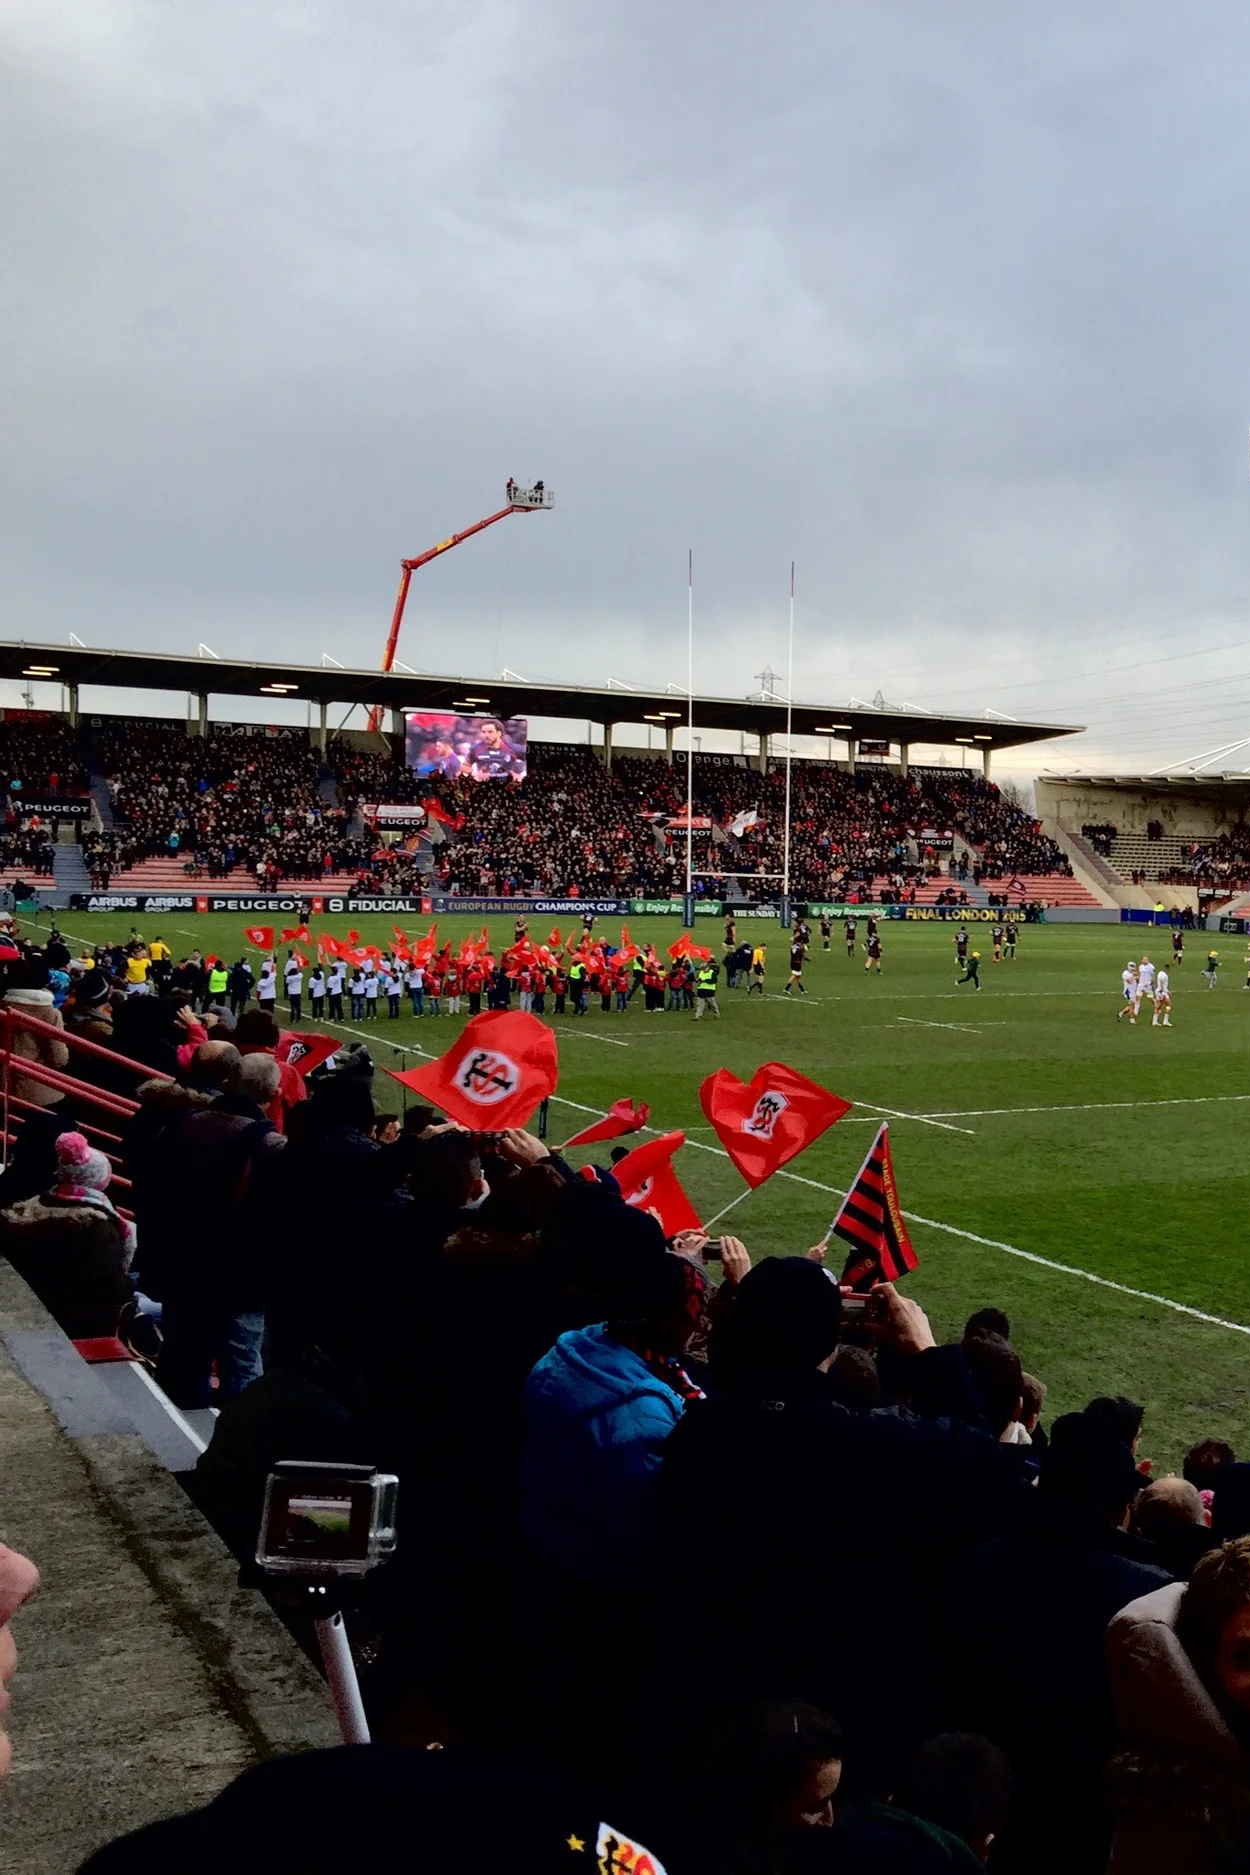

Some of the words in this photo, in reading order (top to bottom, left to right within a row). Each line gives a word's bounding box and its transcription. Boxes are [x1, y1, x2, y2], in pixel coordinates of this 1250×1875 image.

[676, 752, 730, 767] Oange
[24, 804, 89, 813] PEUGEOT
[377, 818, 427, 826] EUGEOT
[88, 897, 138, 907] AIRBUS
[144, 897, 193, 907] AIRBUS
[349, 900, 416, 911] FIDUCIAL
[448, 902, 501, 911] EUROPEAN
[502, 902, 535, 911] RUGBY
[535, 902, 595, 911] CHAMPIONS
[597, 903, 617, 911] CUP
[646, 903, 670, 913] Enjoy
[671, 904, 719, 915] Resnsibly
[822, 907, 843, 916] Enjoy
[906, 908, 942, 919] FINAL
[945, 909, 999, 920] LONDON
[1002, 911, 1026, 921] 2015
[882, 1158, 891, 1188] STADE
[886, 1188, 905, 1243] TOULOUSAIN
